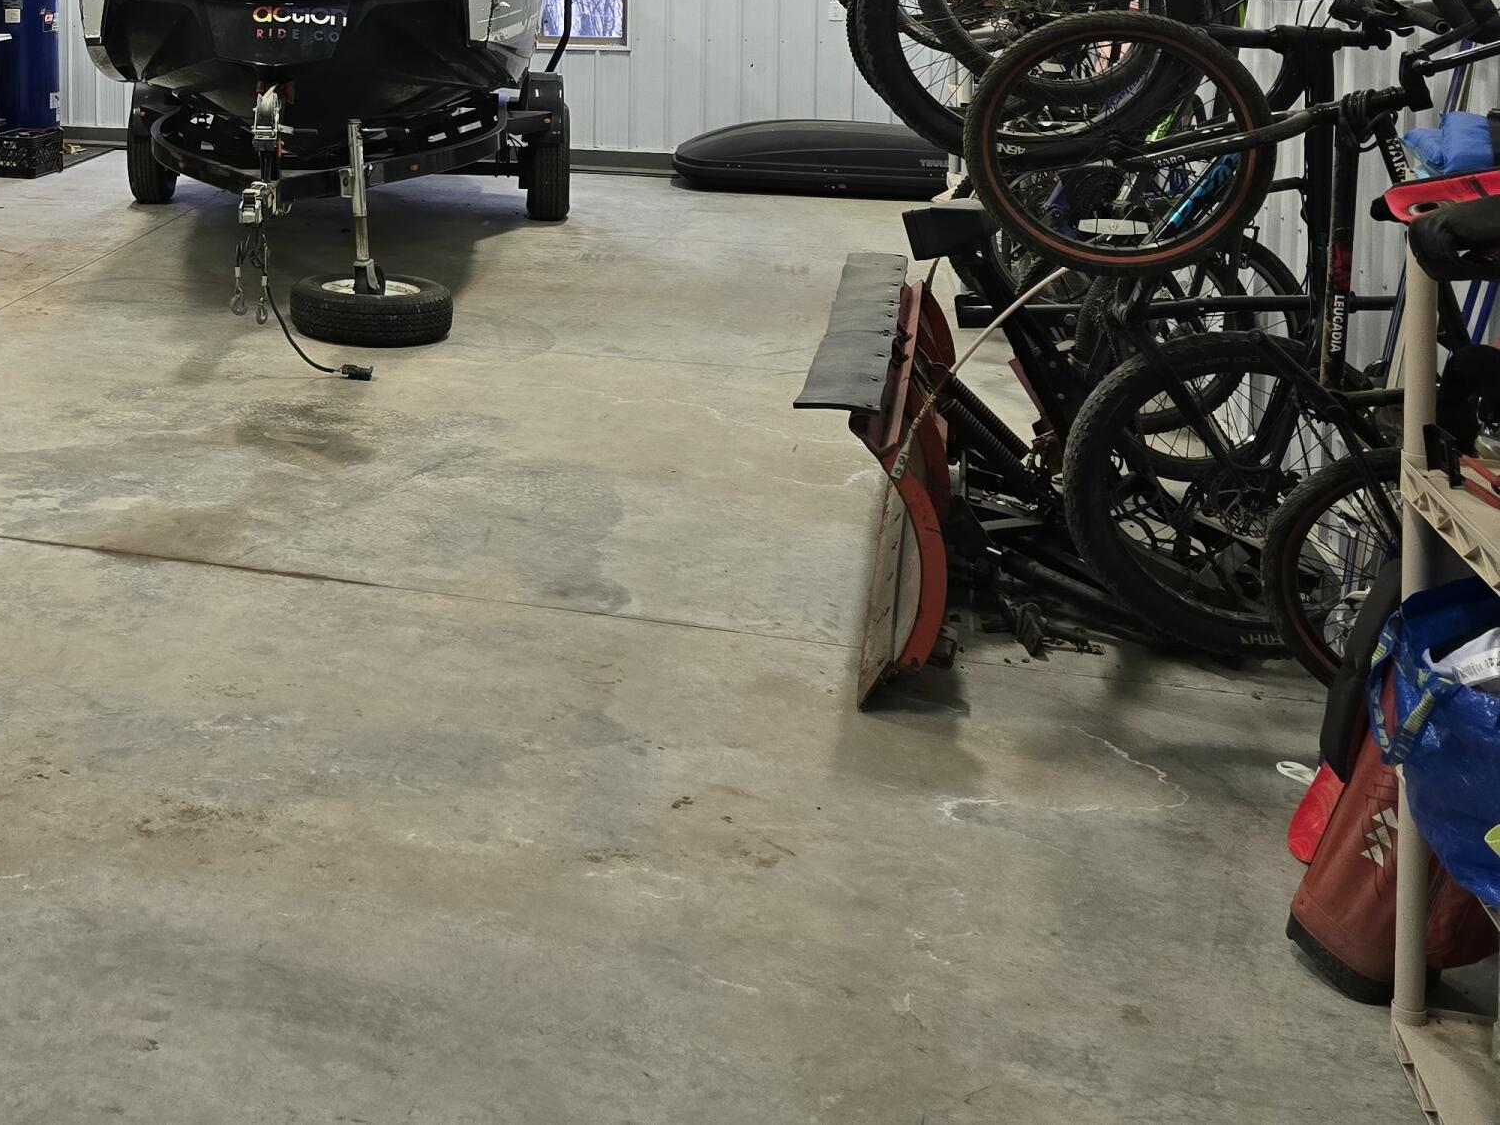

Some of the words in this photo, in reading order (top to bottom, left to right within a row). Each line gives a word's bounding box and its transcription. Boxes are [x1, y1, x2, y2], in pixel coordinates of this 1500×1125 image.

[252, 6, 348, 27] action
[256, 28, 301, 40] RIDE
[1329, 294, 1345, 353] LEUCADIA
